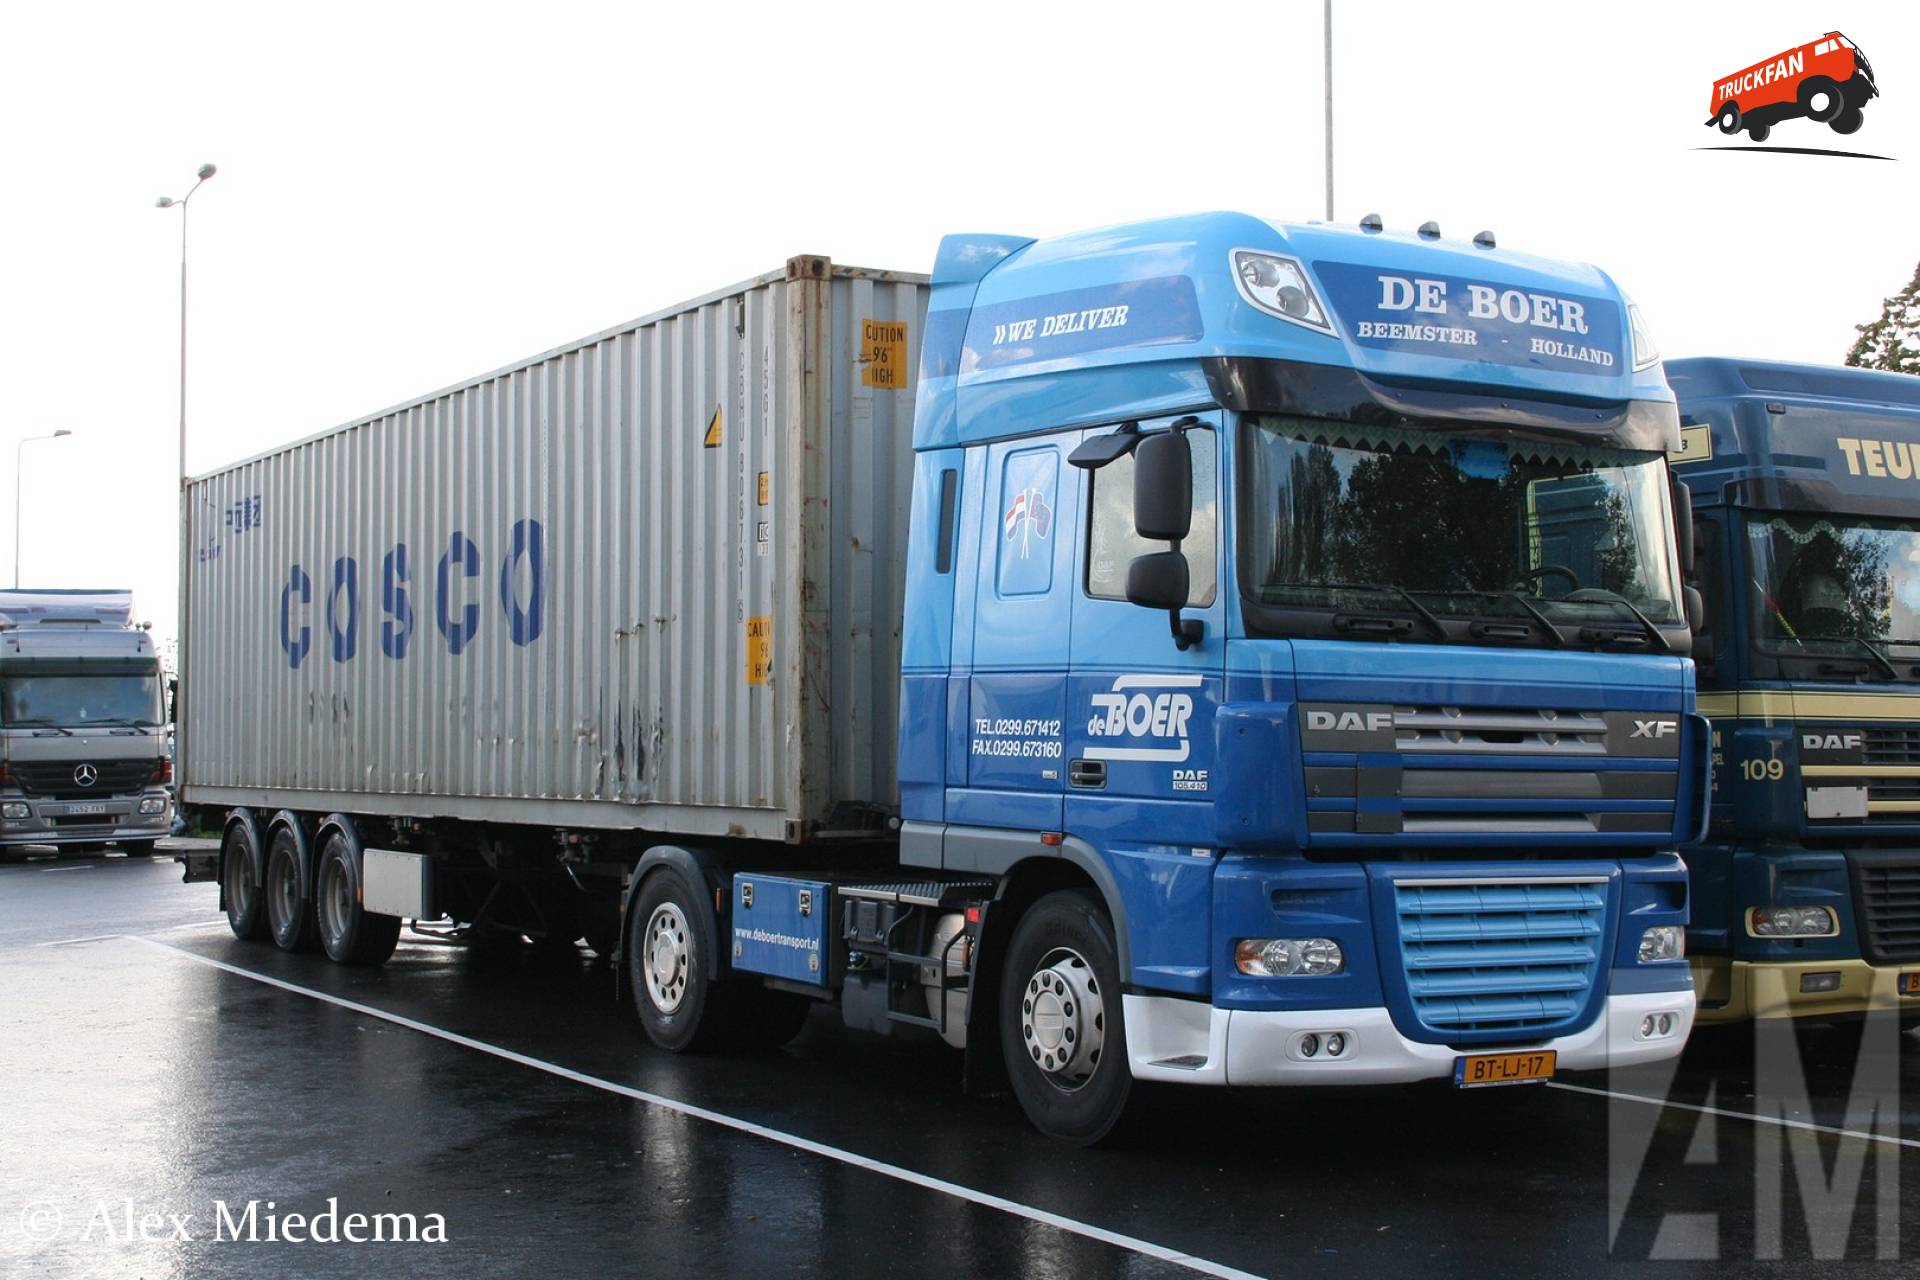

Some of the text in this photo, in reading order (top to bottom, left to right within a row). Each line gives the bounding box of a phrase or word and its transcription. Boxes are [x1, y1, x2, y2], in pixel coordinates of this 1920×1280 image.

[1378, 276, 1589, 335] DE BOER
[1040, 305, 1129, 337] DELIVER
[1358, 321, 1478, 346] BEEMSTER
[1530, 338, 1614, 367] HOLLAND
[280, 518, 547, 669] COSCO
[1307, 711, 1396, 732] DAF
[1630, 720, 1677, 739] XF
[972, 739, 1062, 758] FAX.0299.673160
[1802, 735, 1861, 750] DAF
[1172, 769, 1208, 780] DAF
[1740, 758, 1784, 780] 109
[735, 927, 819, 951] www.deboertransport.nl
[1474, 1057, 1544, 1079] BT-LJ-17
